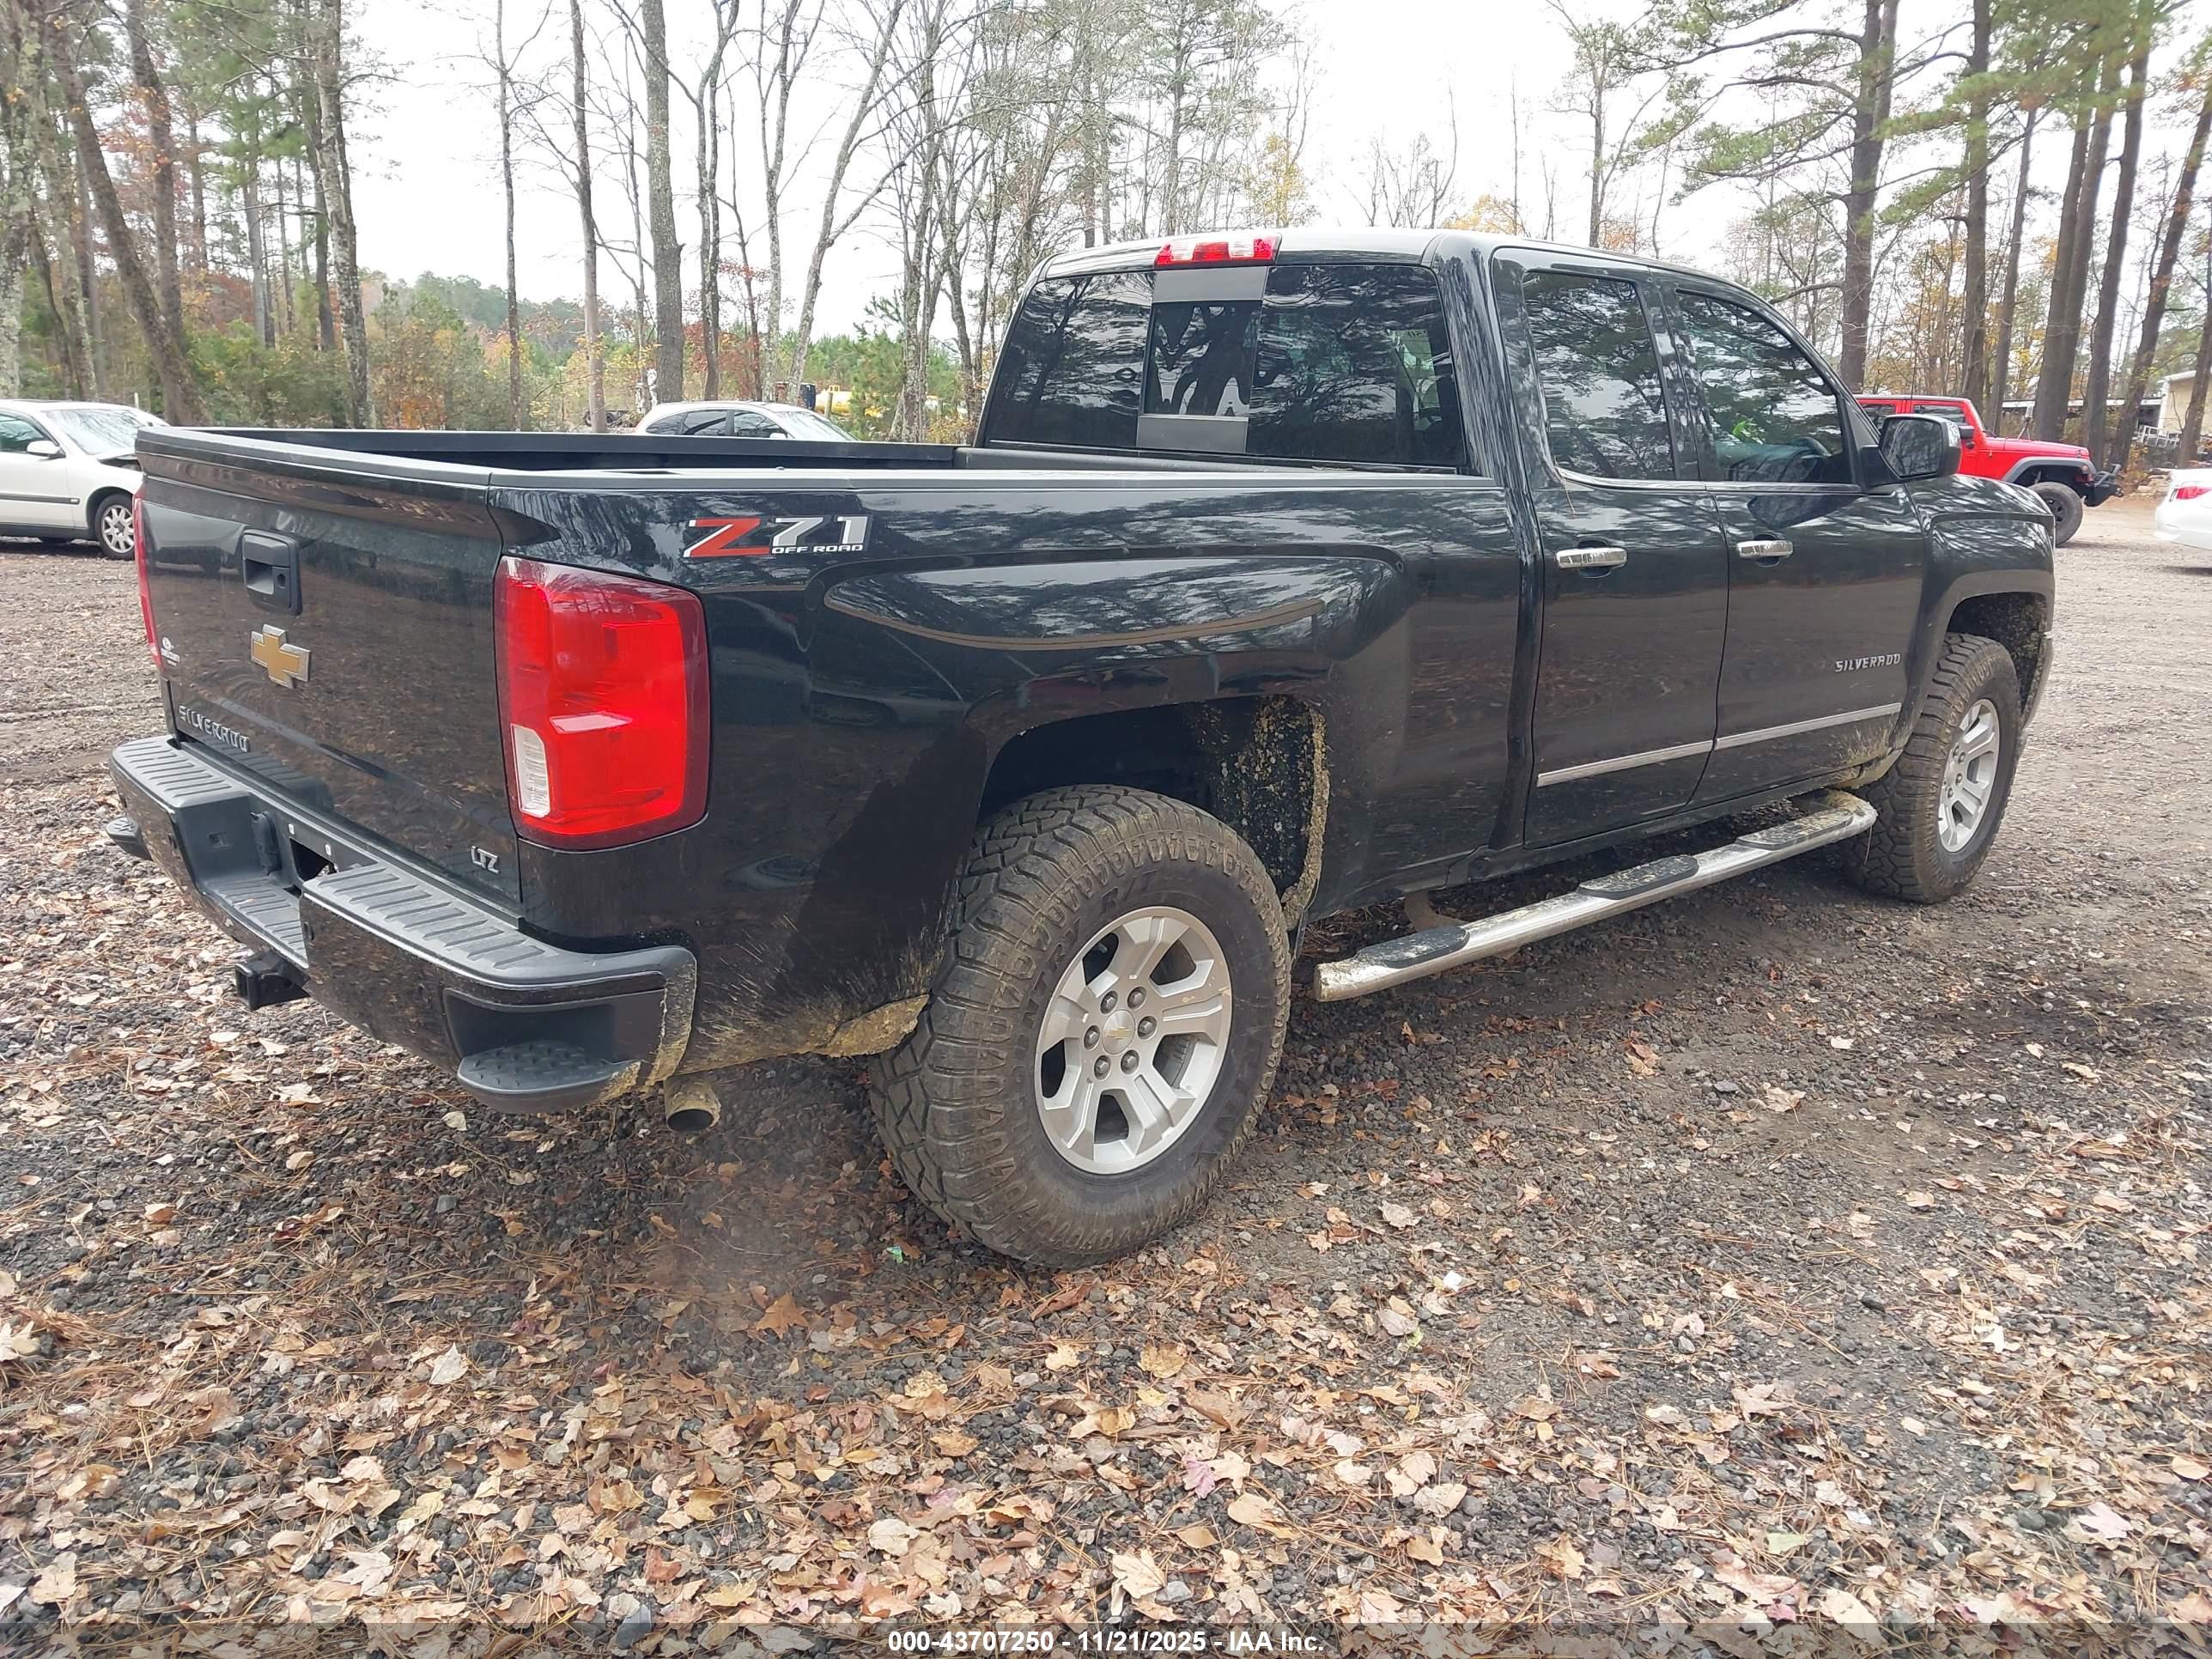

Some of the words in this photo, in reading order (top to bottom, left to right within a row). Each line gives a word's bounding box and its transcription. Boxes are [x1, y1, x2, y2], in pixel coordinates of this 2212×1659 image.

[683, 516, 868, 558] Z71
[771, 545, 808, 555] OFF
[812, 544, 863, 553] ROAD
[1834, 653, 1901, 673] SILVERADO
[179, 705, 249, 753] SILVERADO
[471, 845, 500, 874] LTZ
